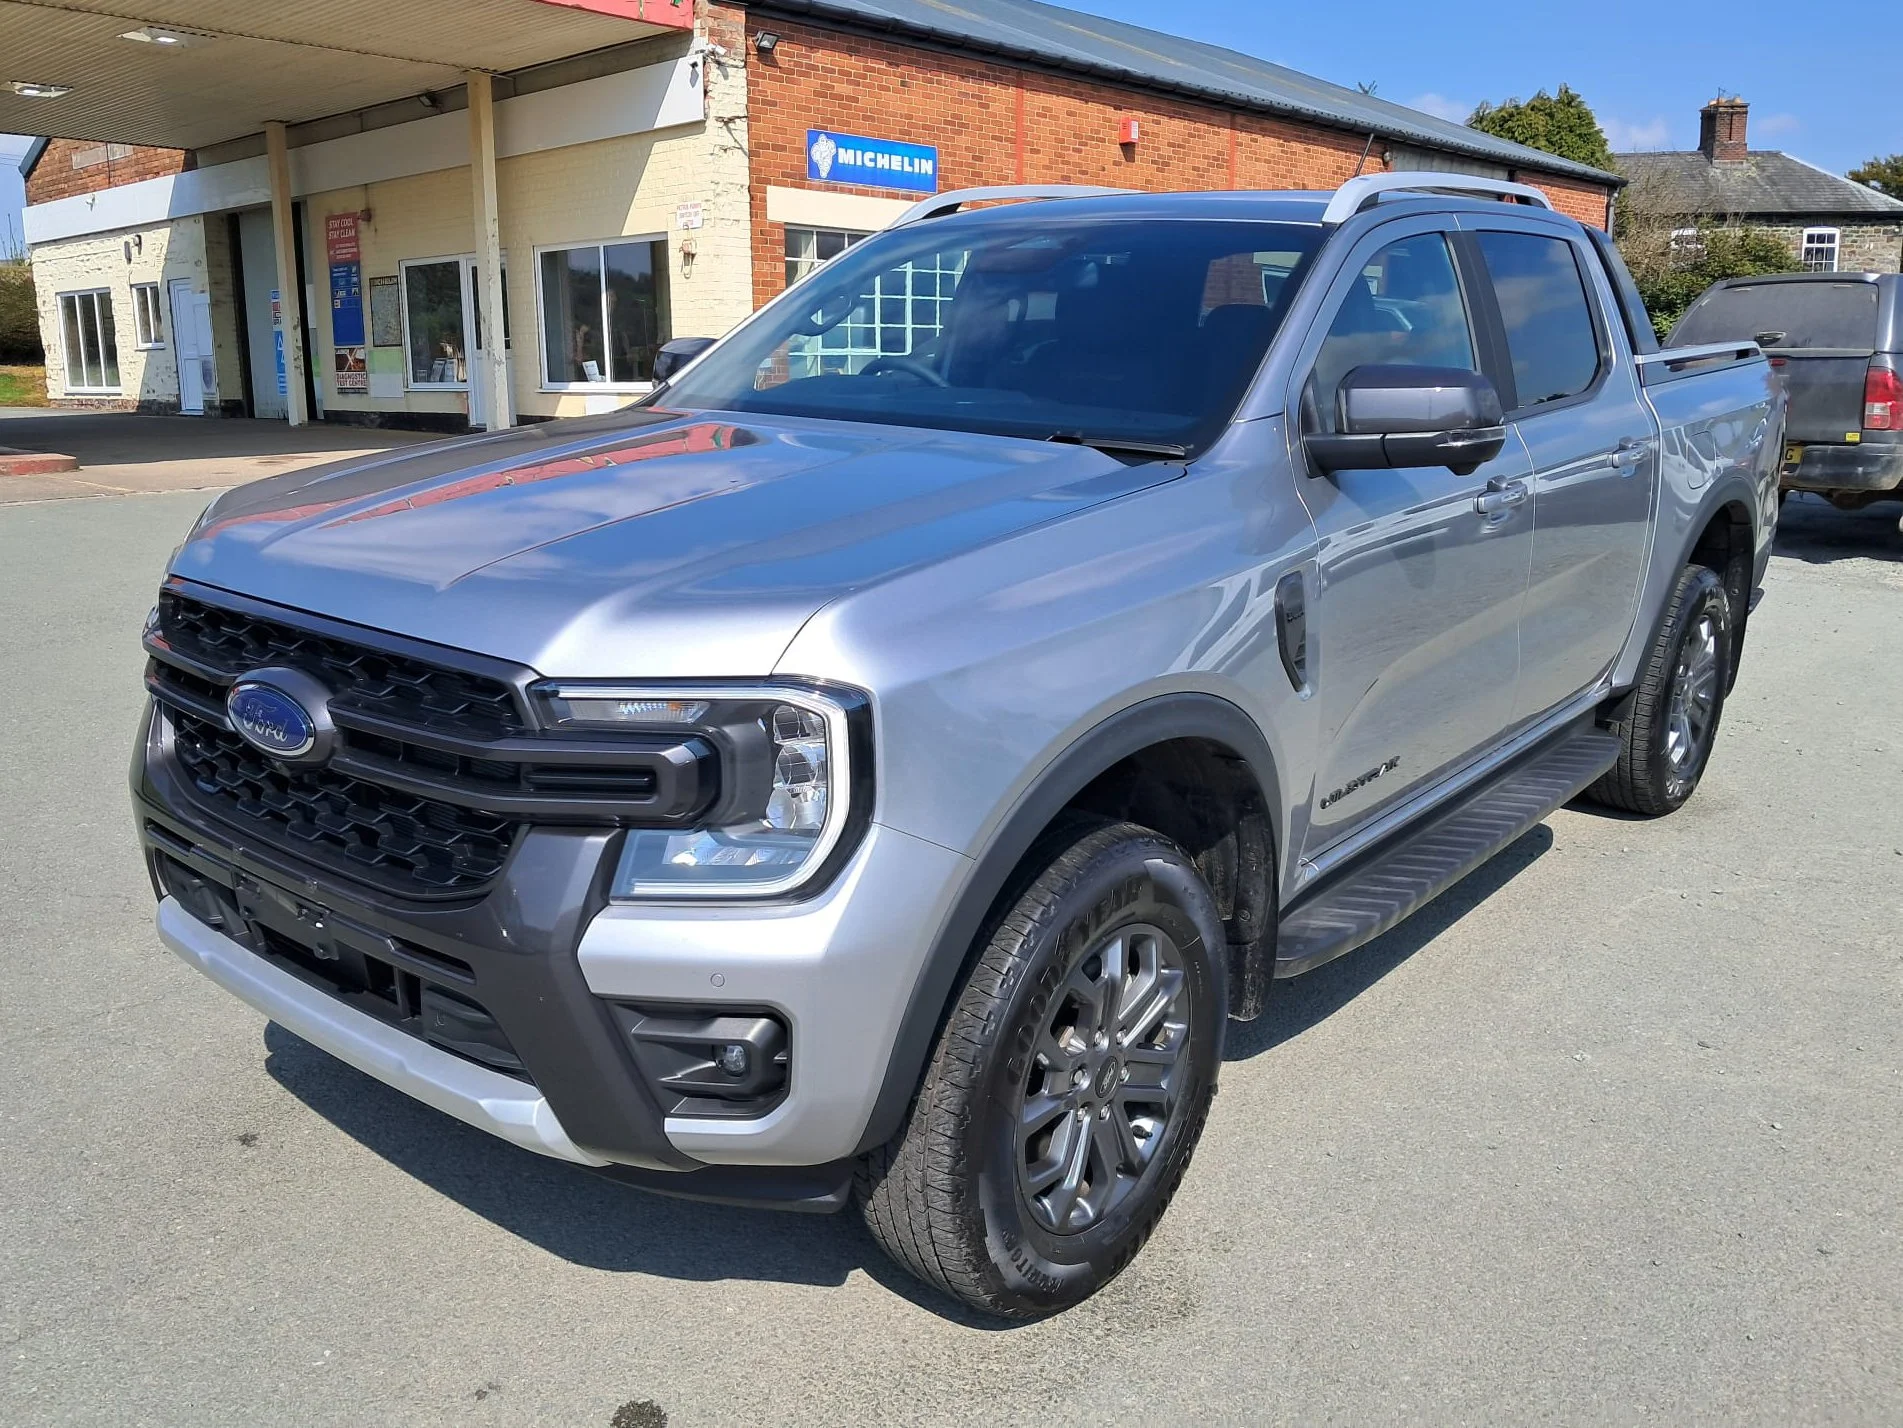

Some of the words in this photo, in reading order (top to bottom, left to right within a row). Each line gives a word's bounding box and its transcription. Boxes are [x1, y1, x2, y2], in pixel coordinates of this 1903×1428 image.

[837, 147, 934, 175] MICHELIN
[328, 219, 340, 229] STAY
[328, 230, 340, 240] STAY
[340, 228, 355, 238] CLEAN
[242, 697, 289, 742] Ford
